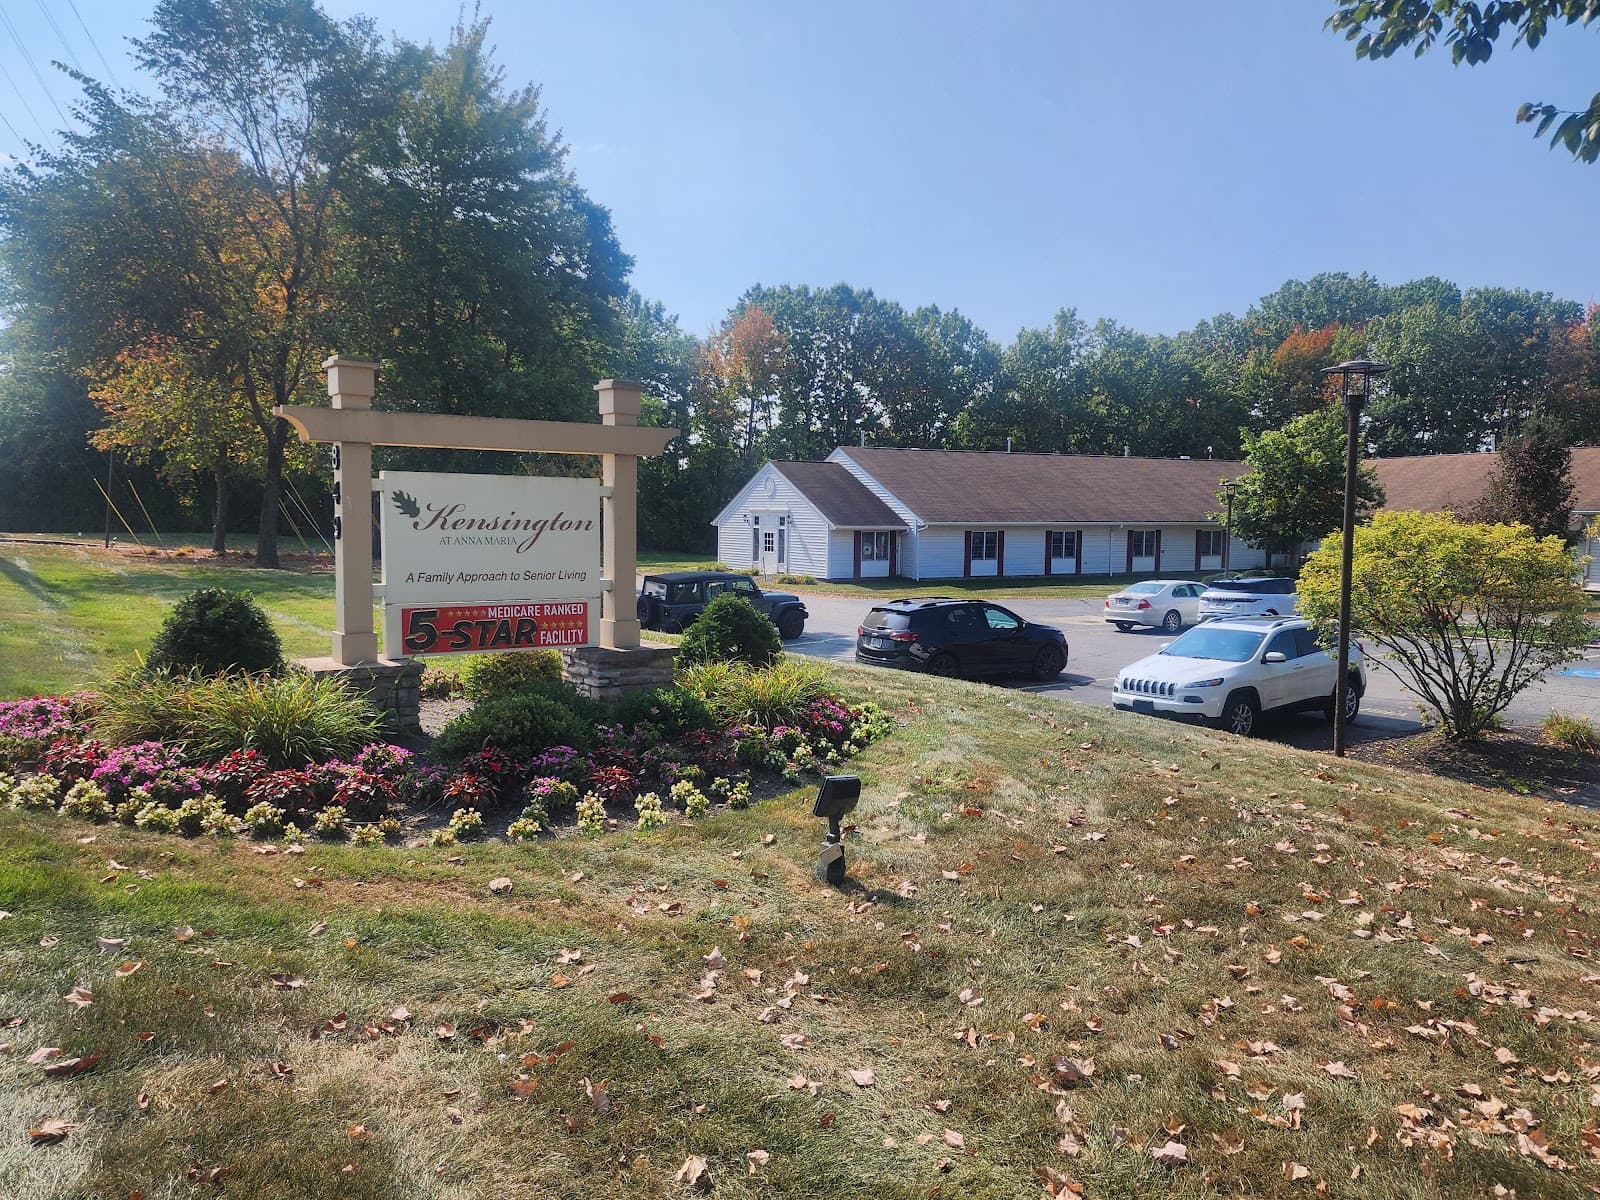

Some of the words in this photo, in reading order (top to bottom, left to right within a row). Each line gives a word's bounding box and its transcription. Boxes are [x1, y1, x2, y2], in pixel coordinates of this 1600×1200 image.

[412, 502, 593, 554] Kensington
[439, 536, 453, 545] AT
[454, 536, 483, 545] ANNA
[484, 536, 518, 545] MARIA
[405, 572, 415, 583] A
[417, 571, 455, 585] Family
[456, 570, 508, 584] Approach
[510, 571, 520, 581] to
[522, 569, 556, 581] Senior
[558, 569, 587, 582] Living
[488, 605, 541, 618] MEDICARE
[543, 603, 584, 616] RANKED
[405, 609, 538, 652] 5-STAR
[540, 629, 584, 645] FACILITY
